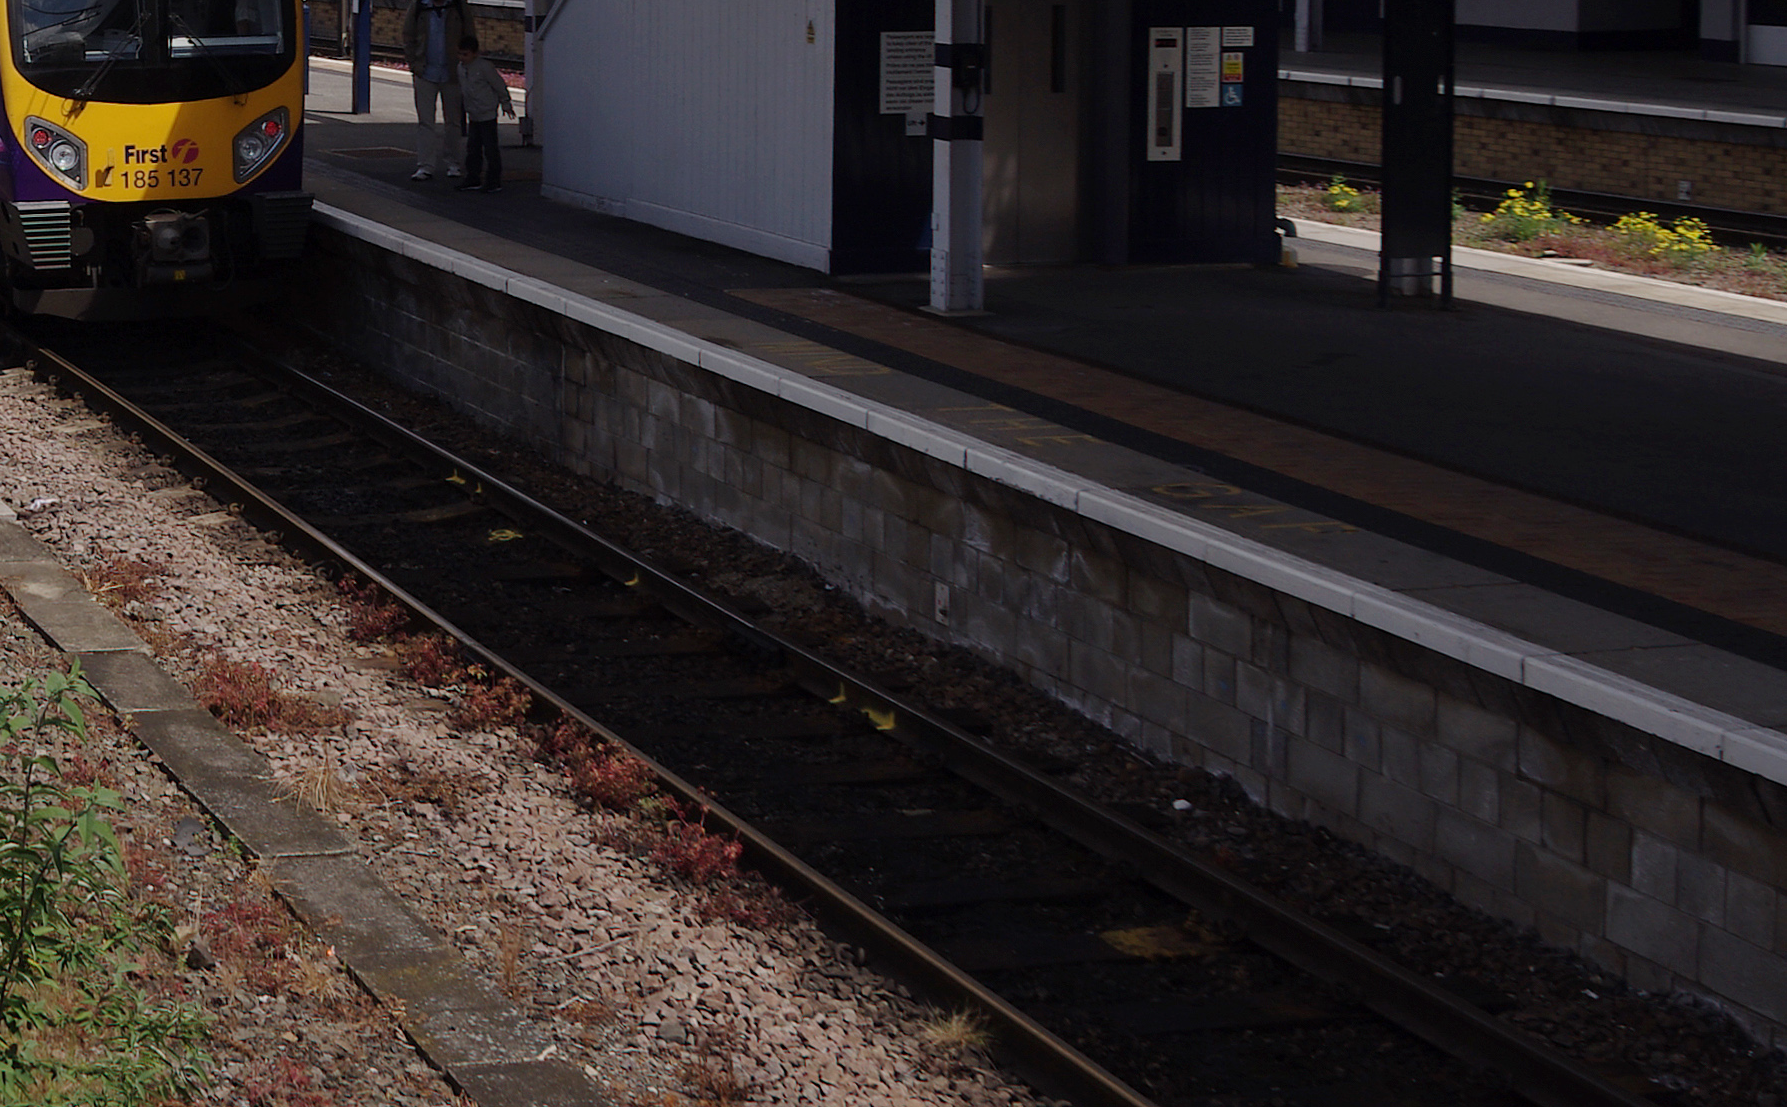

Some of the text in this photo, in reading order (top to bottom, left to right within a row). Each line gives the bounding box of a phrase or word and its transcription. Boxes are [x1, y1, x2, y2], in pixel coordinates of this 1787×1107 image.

[125, 145, 168, 164] First
[121, 168, 203, 189] 185 137
